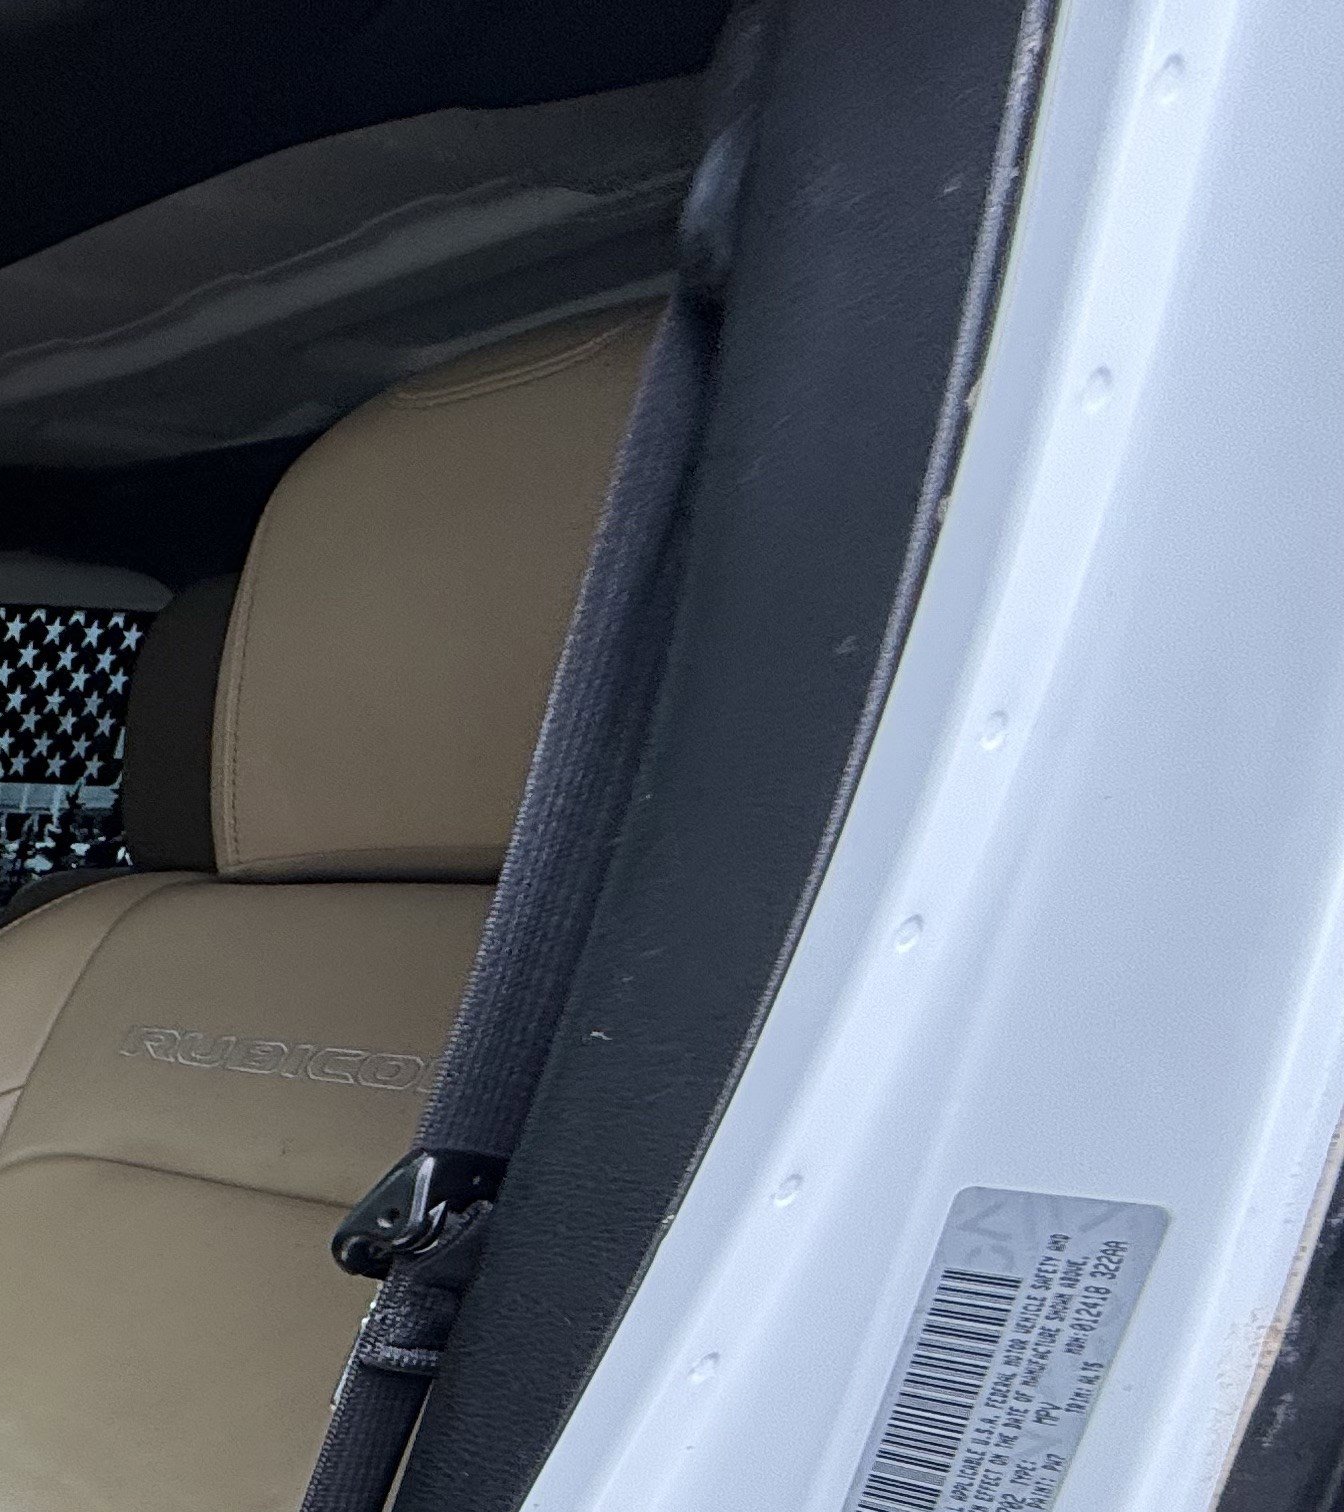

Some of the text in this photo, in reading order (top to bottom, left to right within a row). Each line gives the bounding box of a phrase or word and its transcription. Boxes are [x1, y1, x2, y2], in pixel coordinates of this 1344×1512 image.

[119, 1024, 443, 1094] RUBICO
[1044, 1232, 1072, 1252] AND
[1029, 1255, 1063, 1291] SAFETY
[1012, 1294, 1047, 1335] VEHICLE
[1043, 1292, 1074, 1322] SHOWN
[1000, 1337, 1030, 1367] MOTOR
[1009, 1458, 1038, 1486] TYPE:
[1031, 1400, 1065, 1427] MPV
[1088, 1238, 1131, 1280] 322AA
[1017, 1324, 1062, 1388] MANUFACTURE
[983, 1369, 1017, 1410] FEDERAL
[969, 1412, 1001, 1446] U.S.A.
[1001, 1405, 1029, 1430] DATE
[993, 1431, 1019, 1450] THE
[948, 1447, 986, 1502] APPLICABLE
[972, 1467, 1004, 1502] EFFECT
[1025, 1474, 1058, 1511] PAINT:
